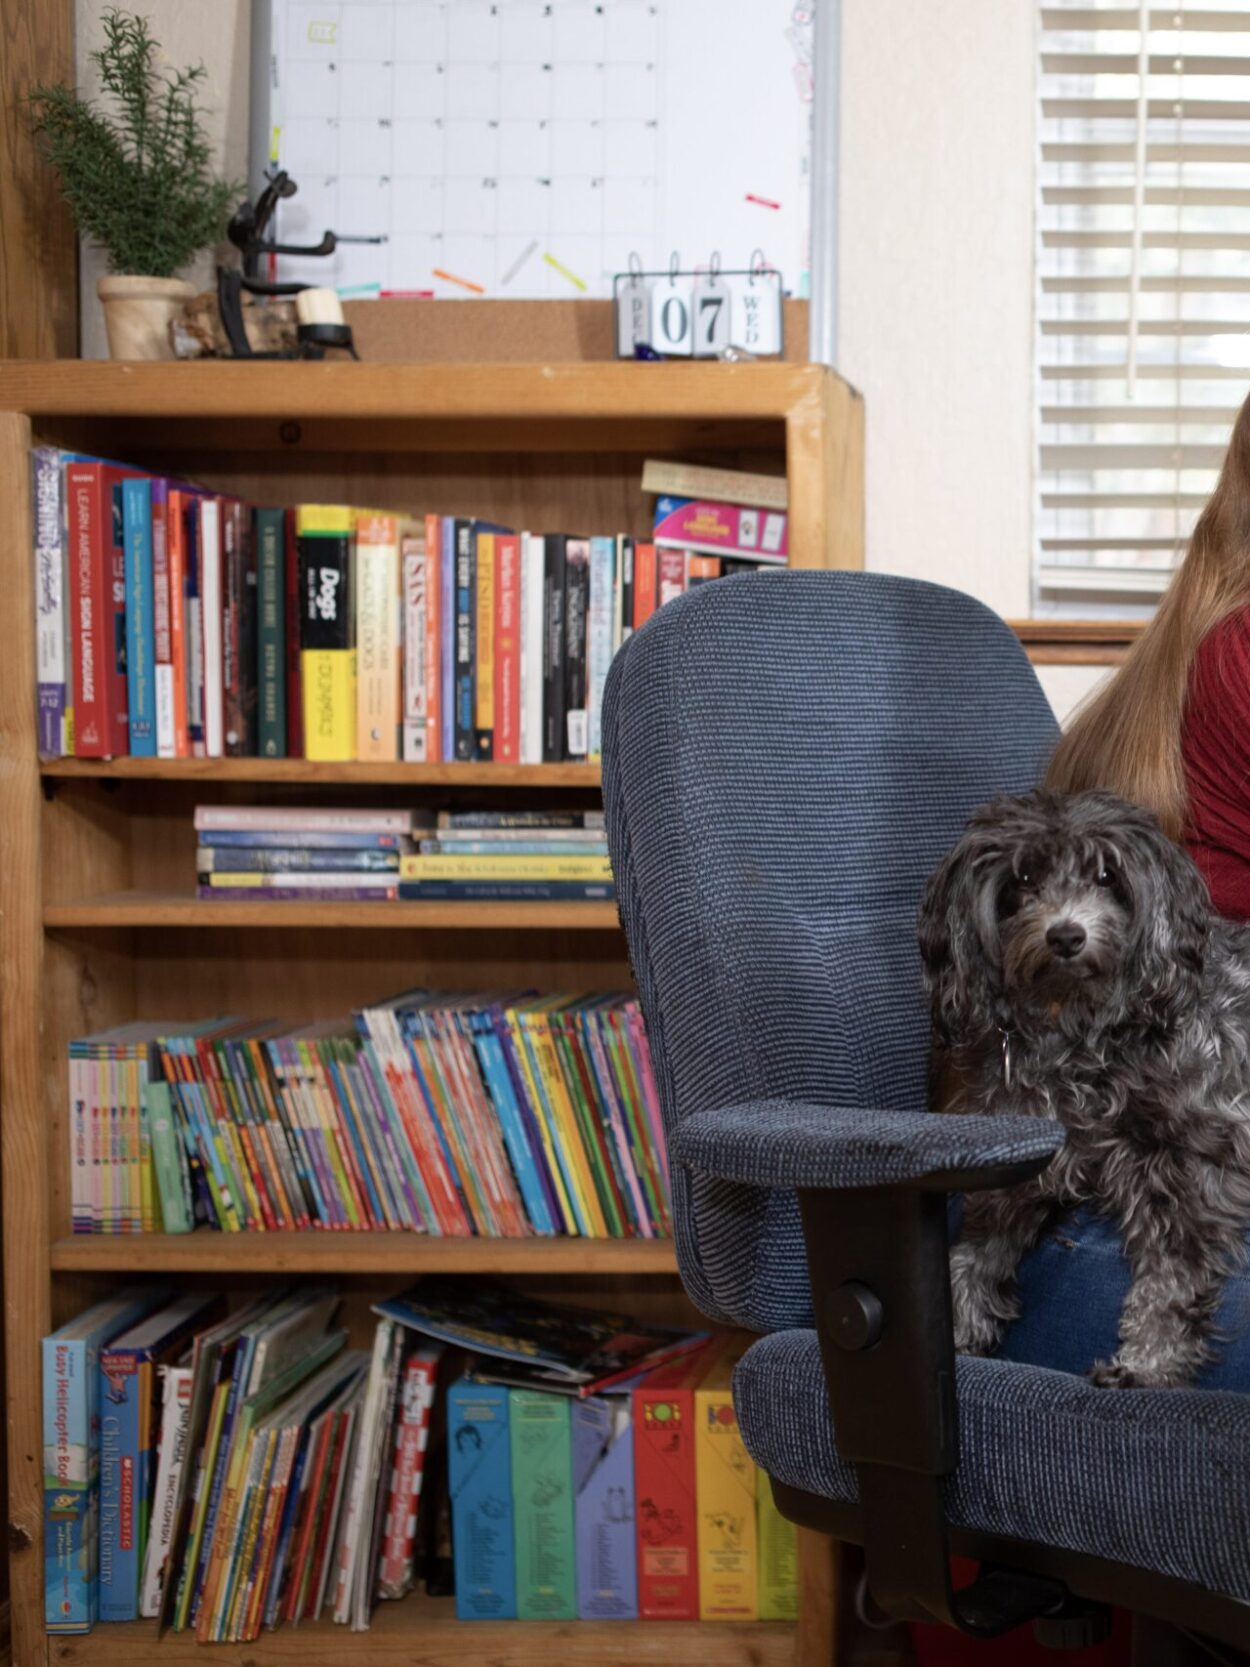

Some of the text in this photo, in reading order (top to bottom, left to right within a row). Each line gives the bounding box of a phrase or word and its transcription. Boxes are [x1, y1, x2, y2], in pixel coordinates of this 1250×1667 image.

[661, 297, 724, 344] 07
[743, 294, 762, 345] WED
[77, 487, 95, 703] LEARN AMERICAN SIGN LANGUAGE
[315, 566, 341, 620] Dogs
[55, 1344, 72, 1488] Busy Helicopter Book
[100, 1415, 121, 1586] Children's Dictionary
[122, 1469, 132, 1549] SCHOLASTIC
[159, 1474, 178, 1546] ENCYCLOPEDIA
